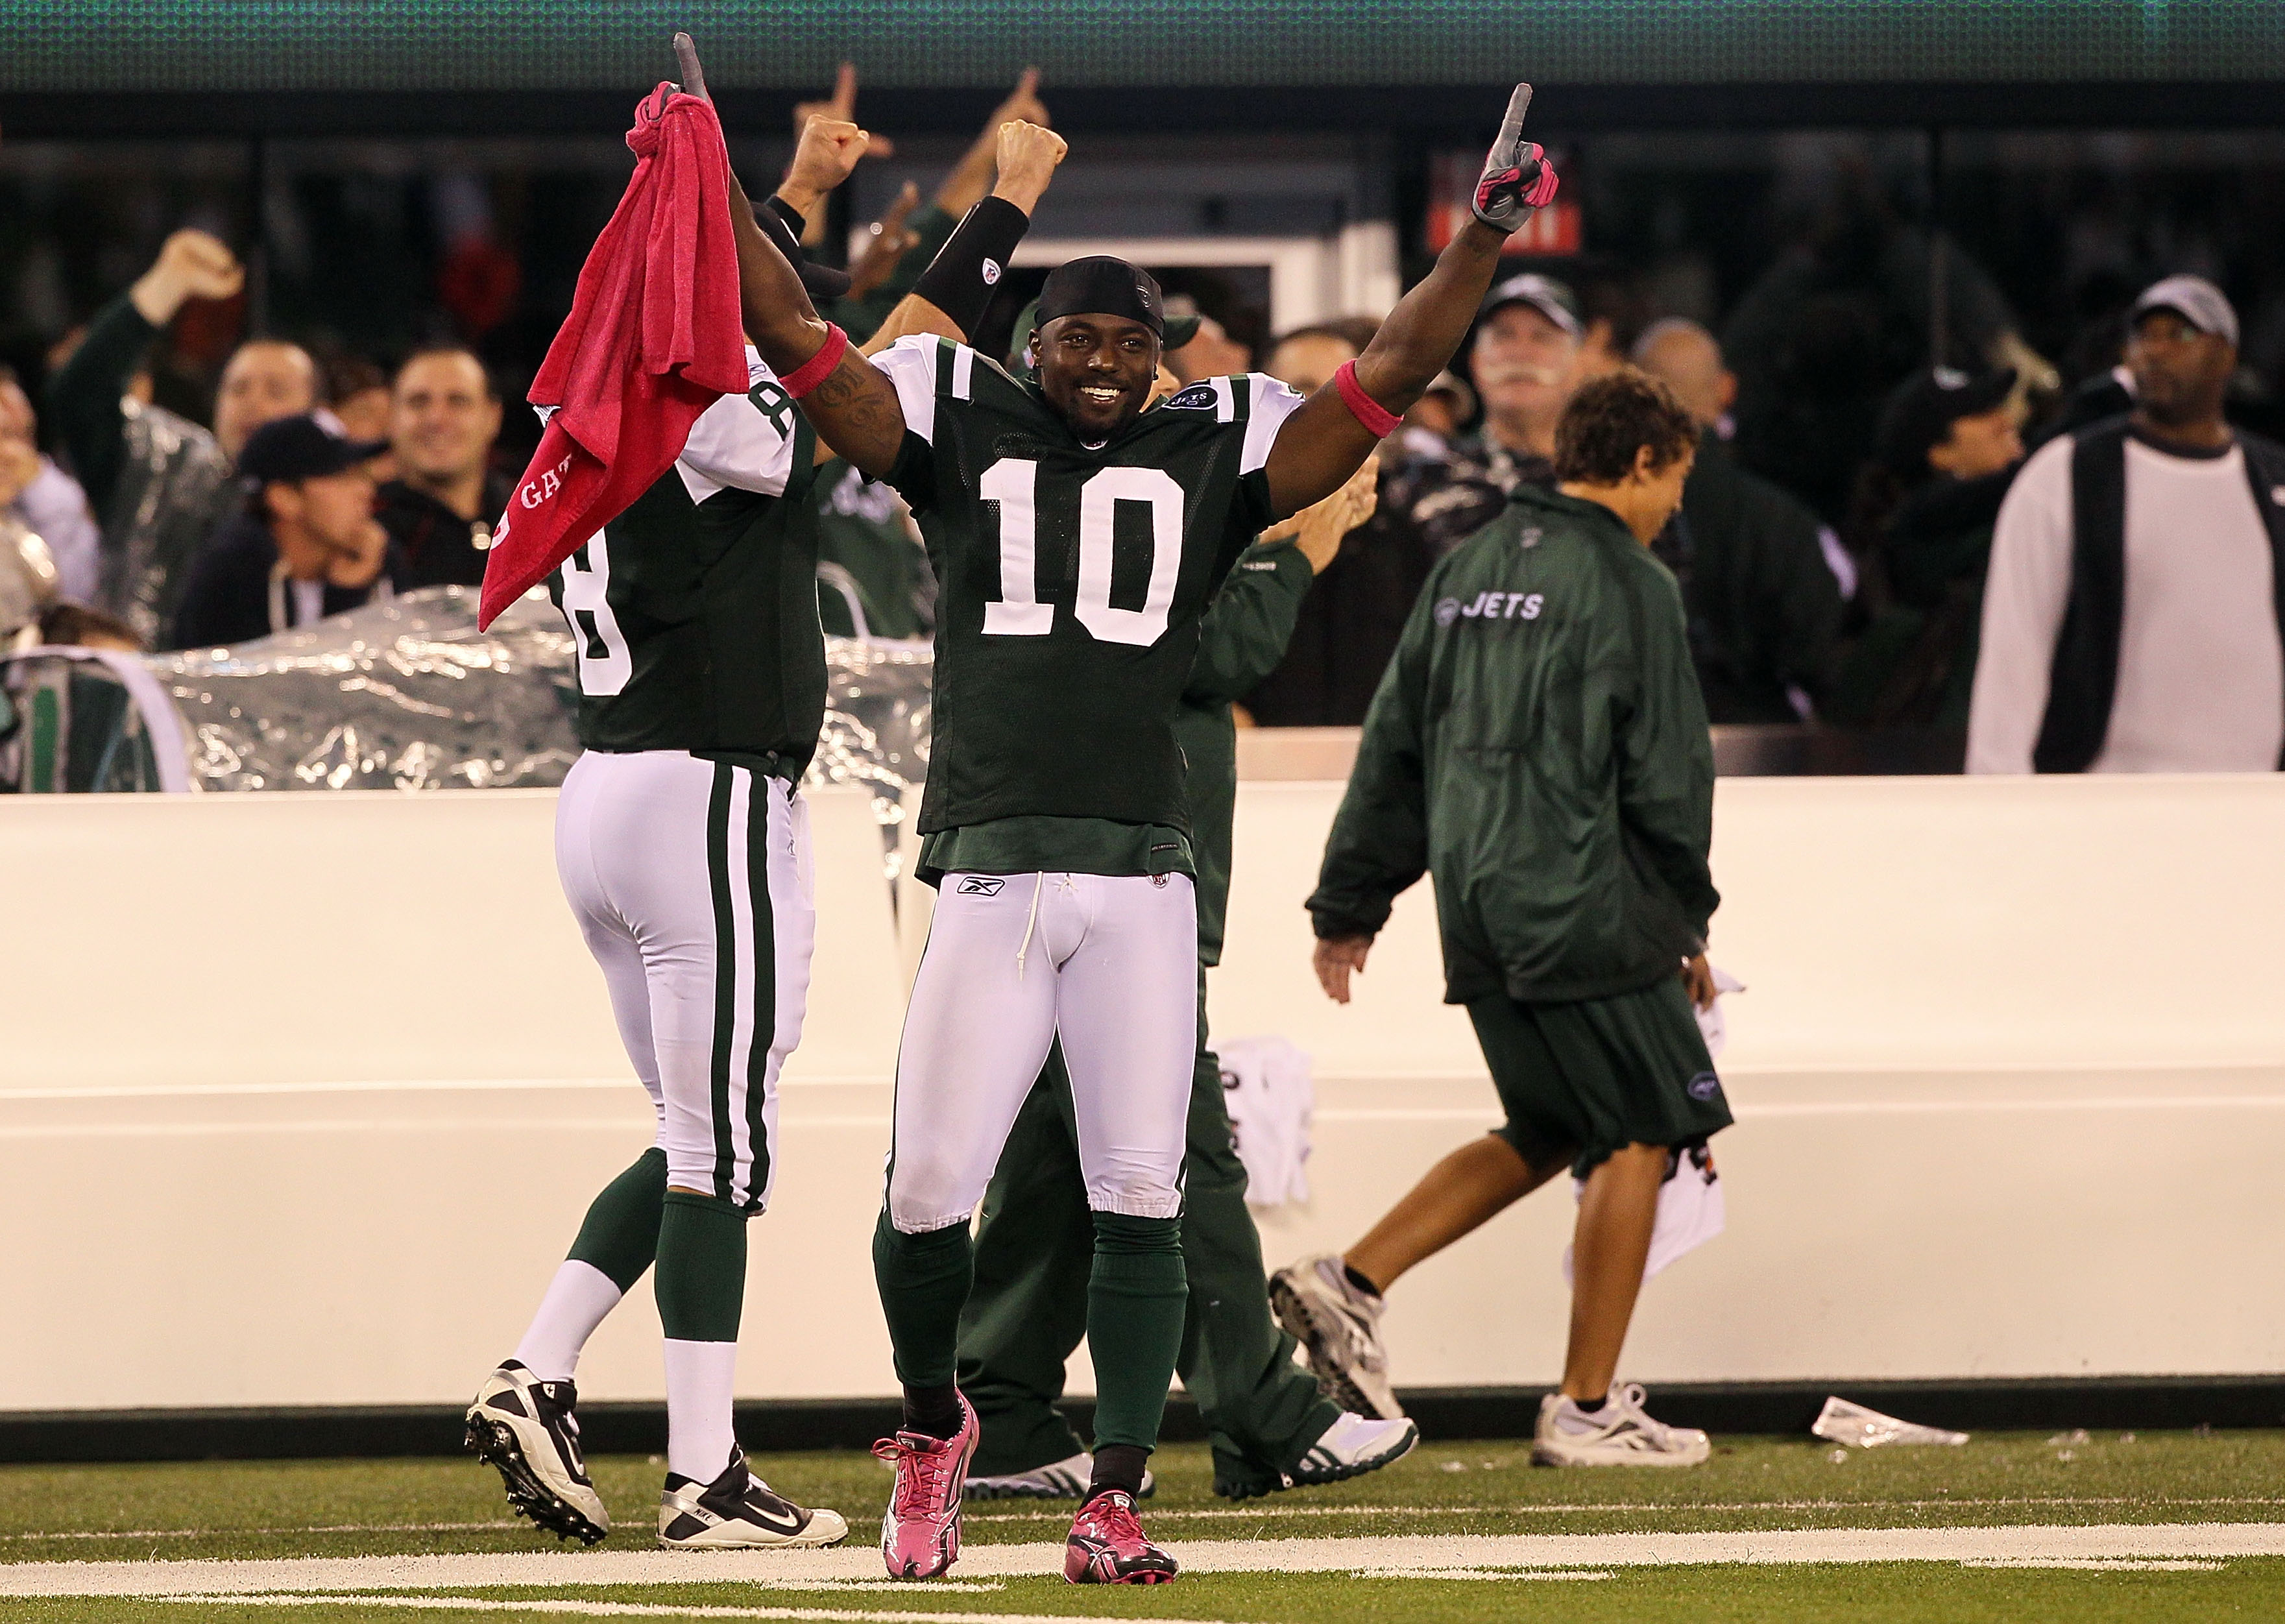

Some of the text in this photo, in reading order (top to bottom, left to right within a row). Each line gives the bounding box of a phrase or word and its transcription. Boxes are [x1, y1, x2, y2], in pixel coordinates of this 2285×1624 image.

[980, 457, 1185, 647] 10
[561, 526, 632, 696] 8
[1461, 590, 1545, 620] JETS
[694, 1508, 712, 1521] NIKE
